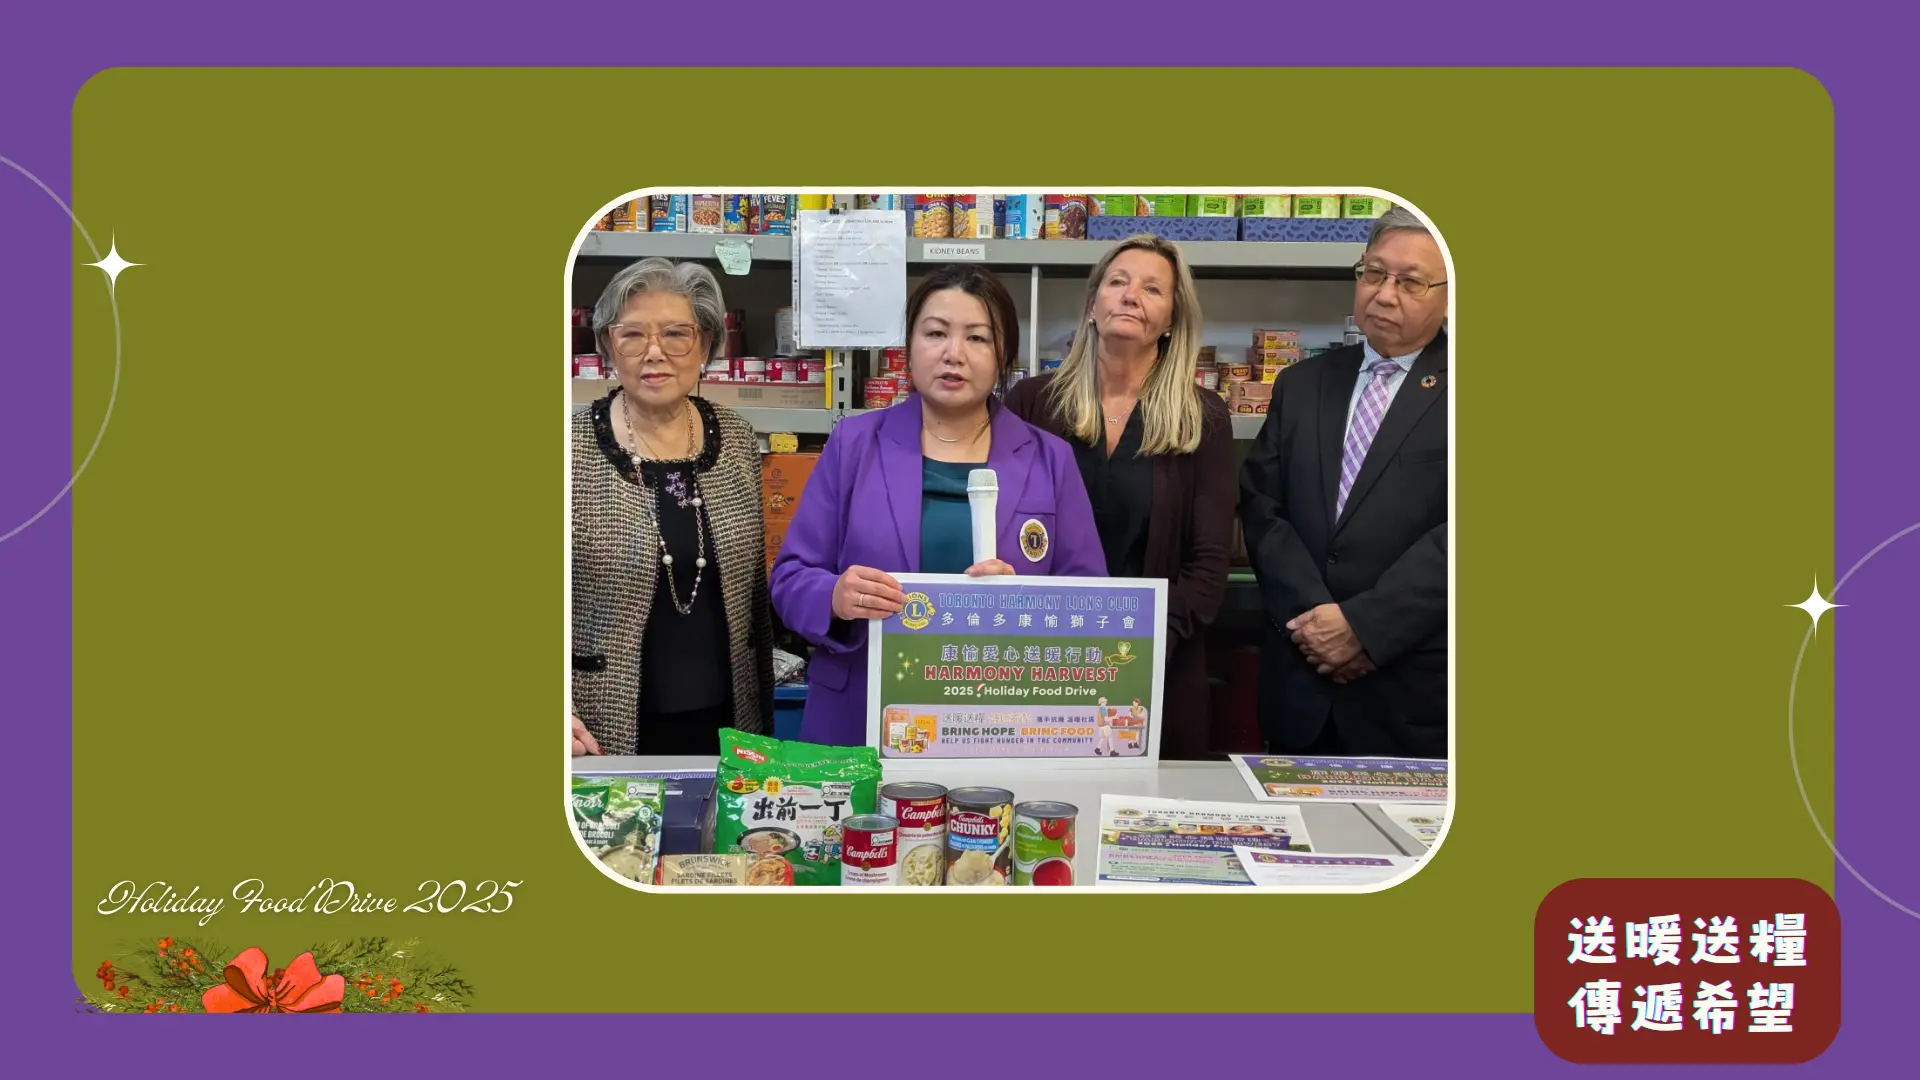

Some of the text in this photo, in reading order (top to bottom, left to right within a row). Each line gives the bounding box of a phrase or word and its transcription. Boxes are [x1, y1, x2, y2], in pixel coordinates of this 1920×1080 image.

[763, 194, 786, 204] FEVES
[929, 247, 955, 255] KIDNEY
[939, 593, 1139, 611] TORONTO HARMONY LIONS CLUB
[911, 603, 922, 617] L
[941, 644, 1103, 664] 康愉愛心送暖行動
[924, 665, 1118, 682] HARMONY HARVEST
[943, 686, 1097, 699] 2025 Holiday Food Drive
[941, 727, 1095, 736] BRING HOPE BRING FOOD
[752, 796, 847, 822] 出前一丁
[950, 819, 996, 836] CHUNKY
[846, 845, 888, 861] Campbell's
[678, 856, 732, 869] BRUNSWICK
